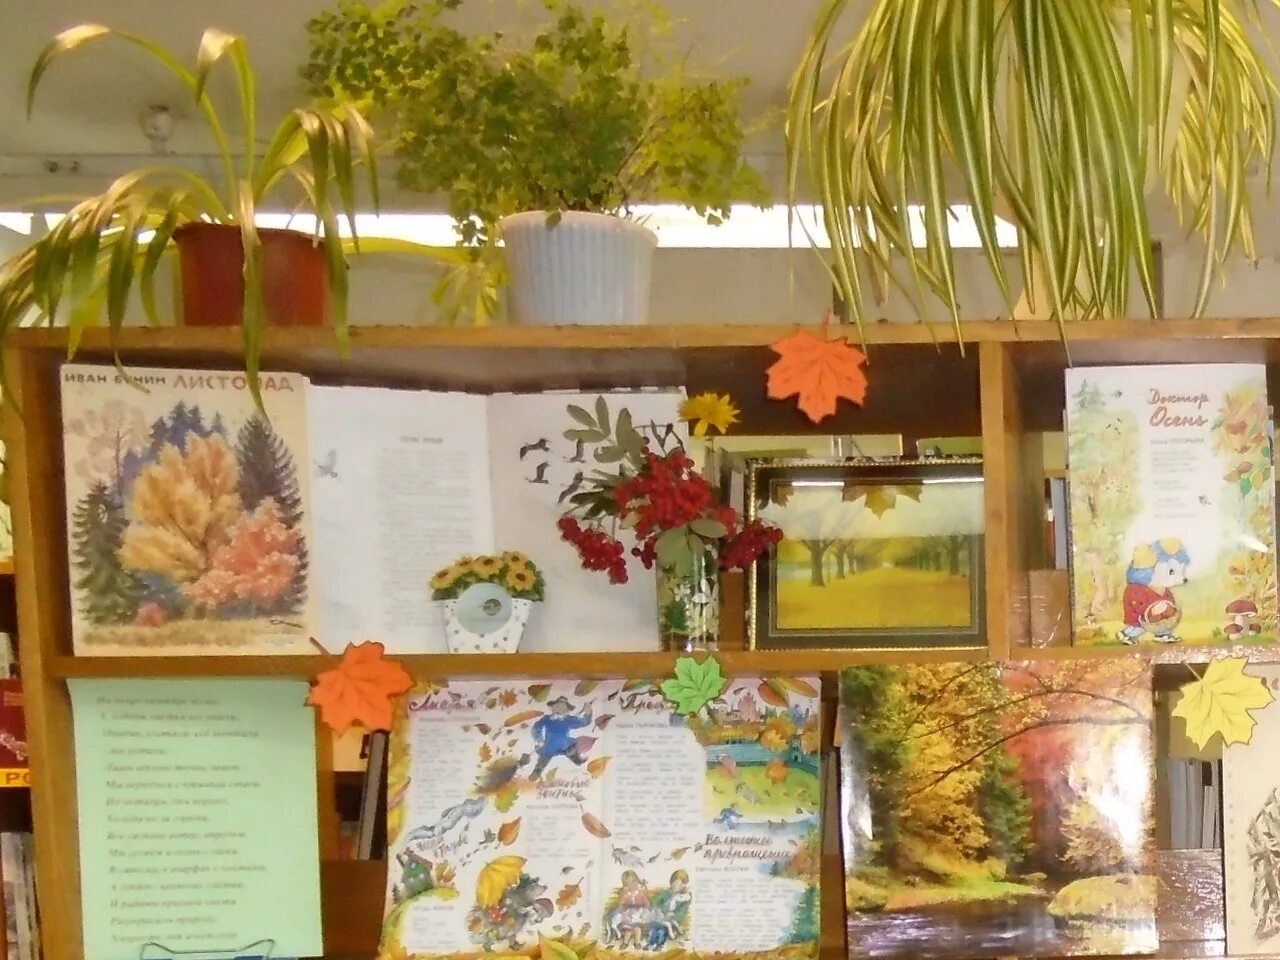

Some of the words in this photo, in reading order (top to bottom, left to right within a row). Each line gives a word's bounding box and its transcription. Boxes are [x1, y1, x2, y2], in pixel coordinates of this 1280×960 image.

[65, 373, 106, 383] ИВАН
[173, 374, 294, 392] ЛИСТОАД
[1149, 406, 1209, 427] Осень
